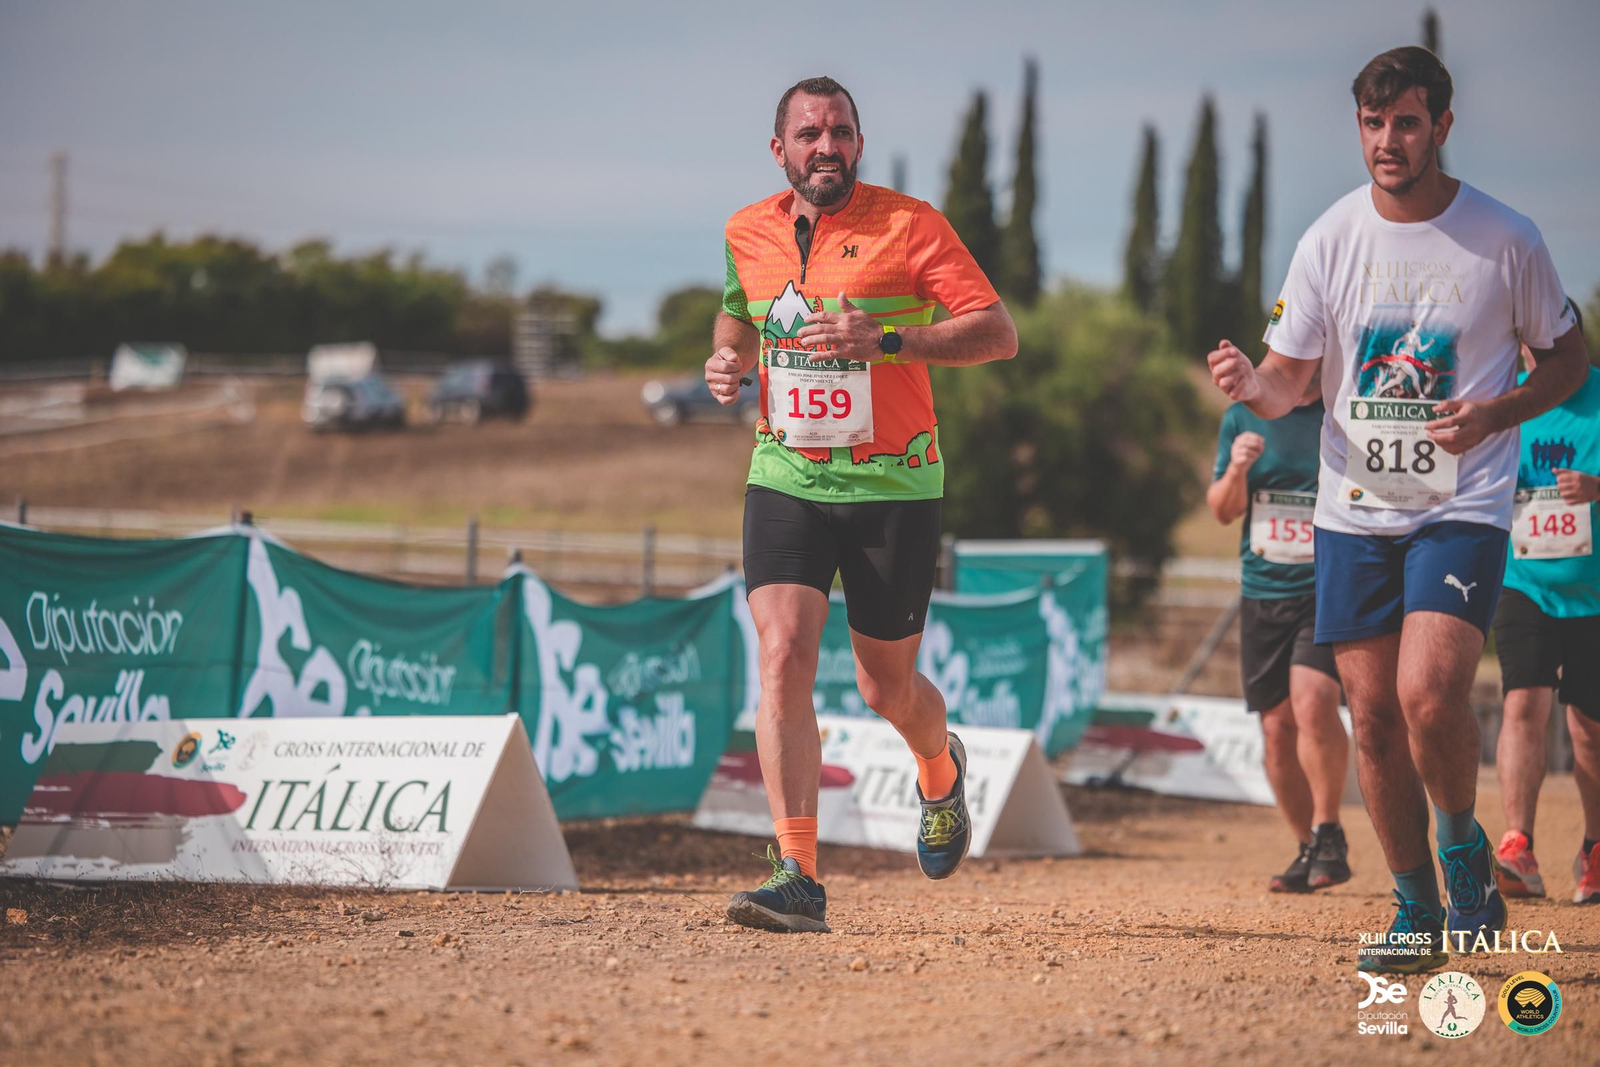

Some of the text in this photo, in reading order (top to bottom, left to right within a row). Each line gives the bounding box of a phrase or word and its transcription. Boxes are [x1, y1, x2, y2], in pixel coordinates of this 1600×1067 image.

[823, 264, 876, 273] SENDERO
[1362, 261, 1452, 279] XLIII CROSS
[838, 284, 911, 295] NATURALEZA
[788, 387, 852, 419] 159
[1374, 403, 1428, 419] ITÁLICA
[1366, 438, 1436, 475] 818
[1269, 517, 1313, 543] 155
[1528, 512, 1577, 537] 148
[26, 591, 183, 666] Diputación
[274, 741, 487, 758] CROSS INTERNACIONAL DE
[246, 764, 453, 833] ITÁLICA
[232, 839, 330, 855] INTERNATIONAL
